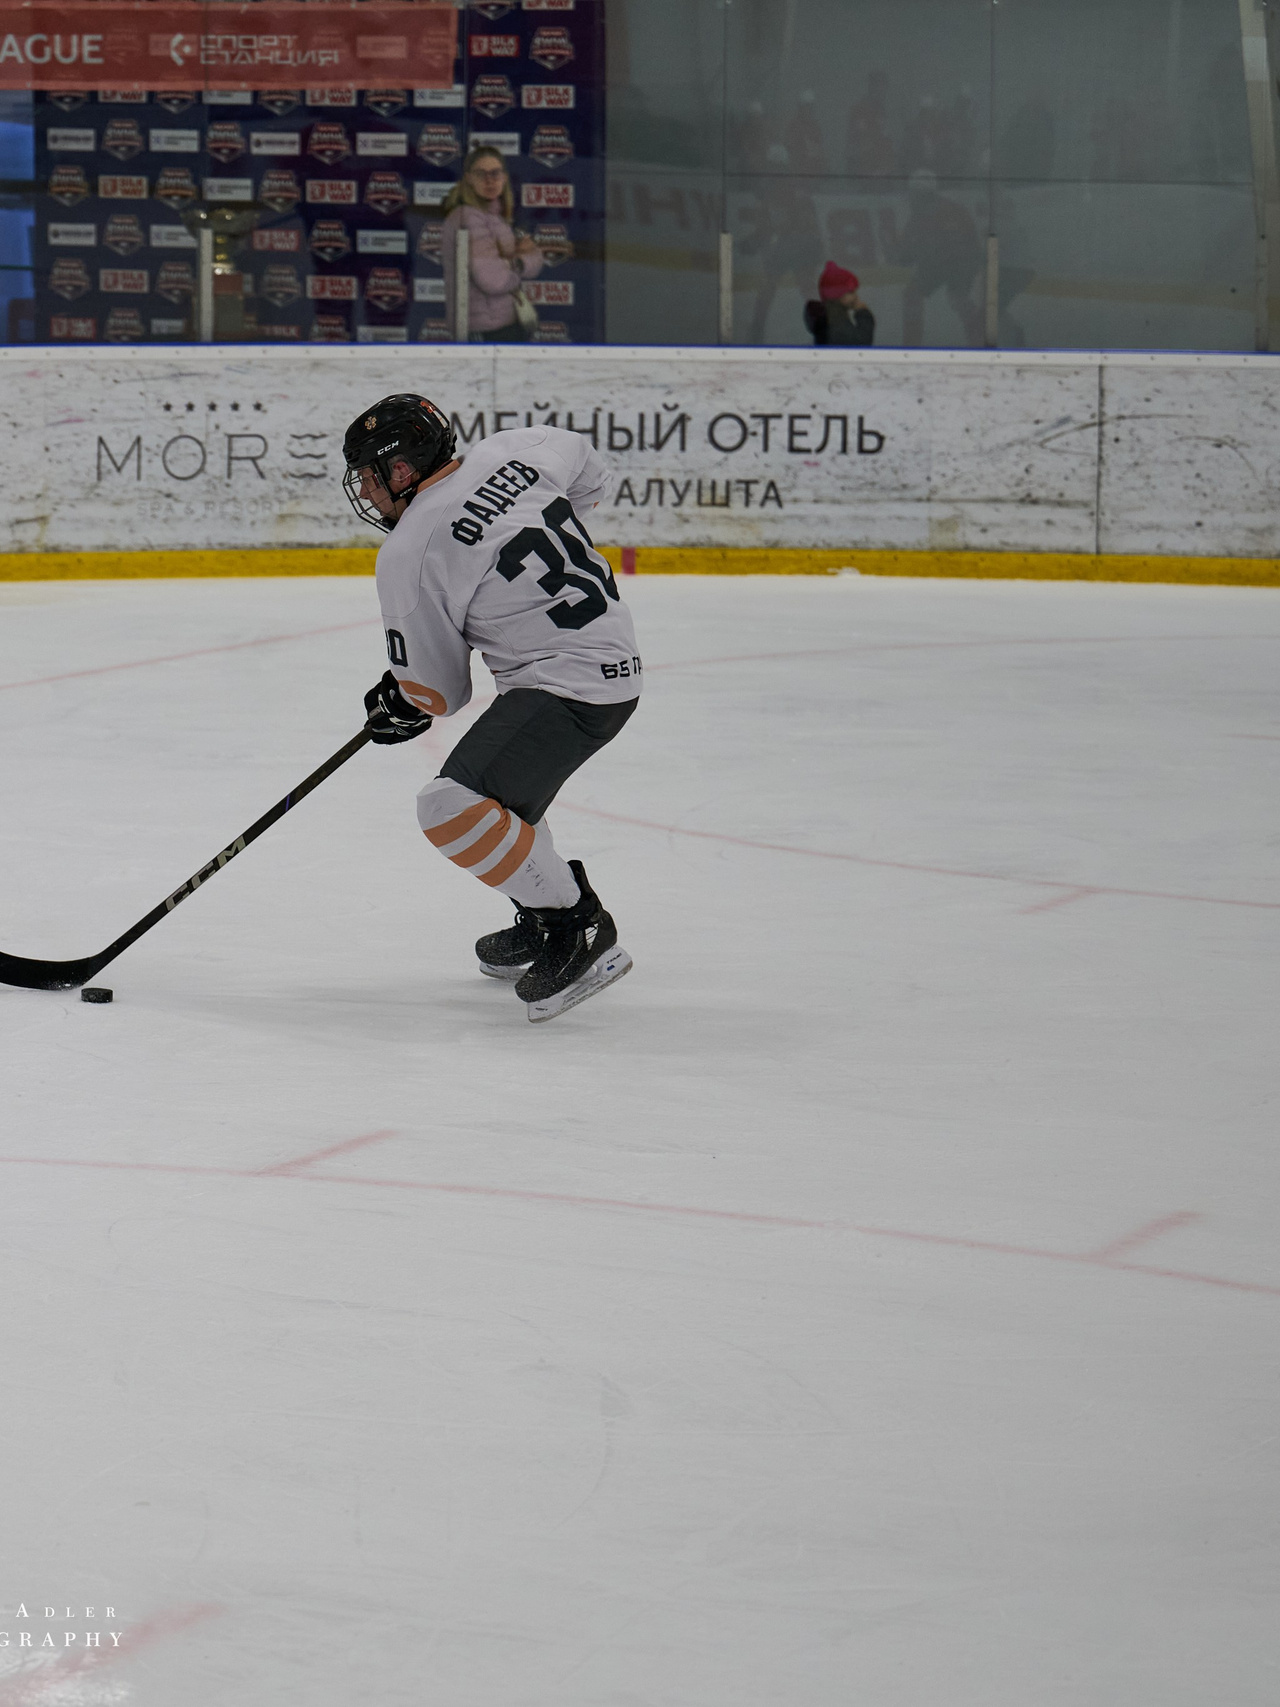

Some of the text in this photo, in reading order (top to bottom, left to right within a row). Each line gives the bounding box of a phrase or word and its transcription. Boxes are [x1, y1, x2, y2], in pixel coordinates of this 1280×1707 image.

[200, 34, 299, 49] СПОРТ
[200, 50, 340, 66] СТАНЦИЯ
[376, 440, 400, 456] CCM
[708, 412, 884, 454] ОТЕЛЬ
[451, 460, 540, 546] ФАДЕЕВ
[614, 479, 783, 508] АЛУШТА
[495, 496, 621, 631] 30
[165, 834, 247, 912] CCM
